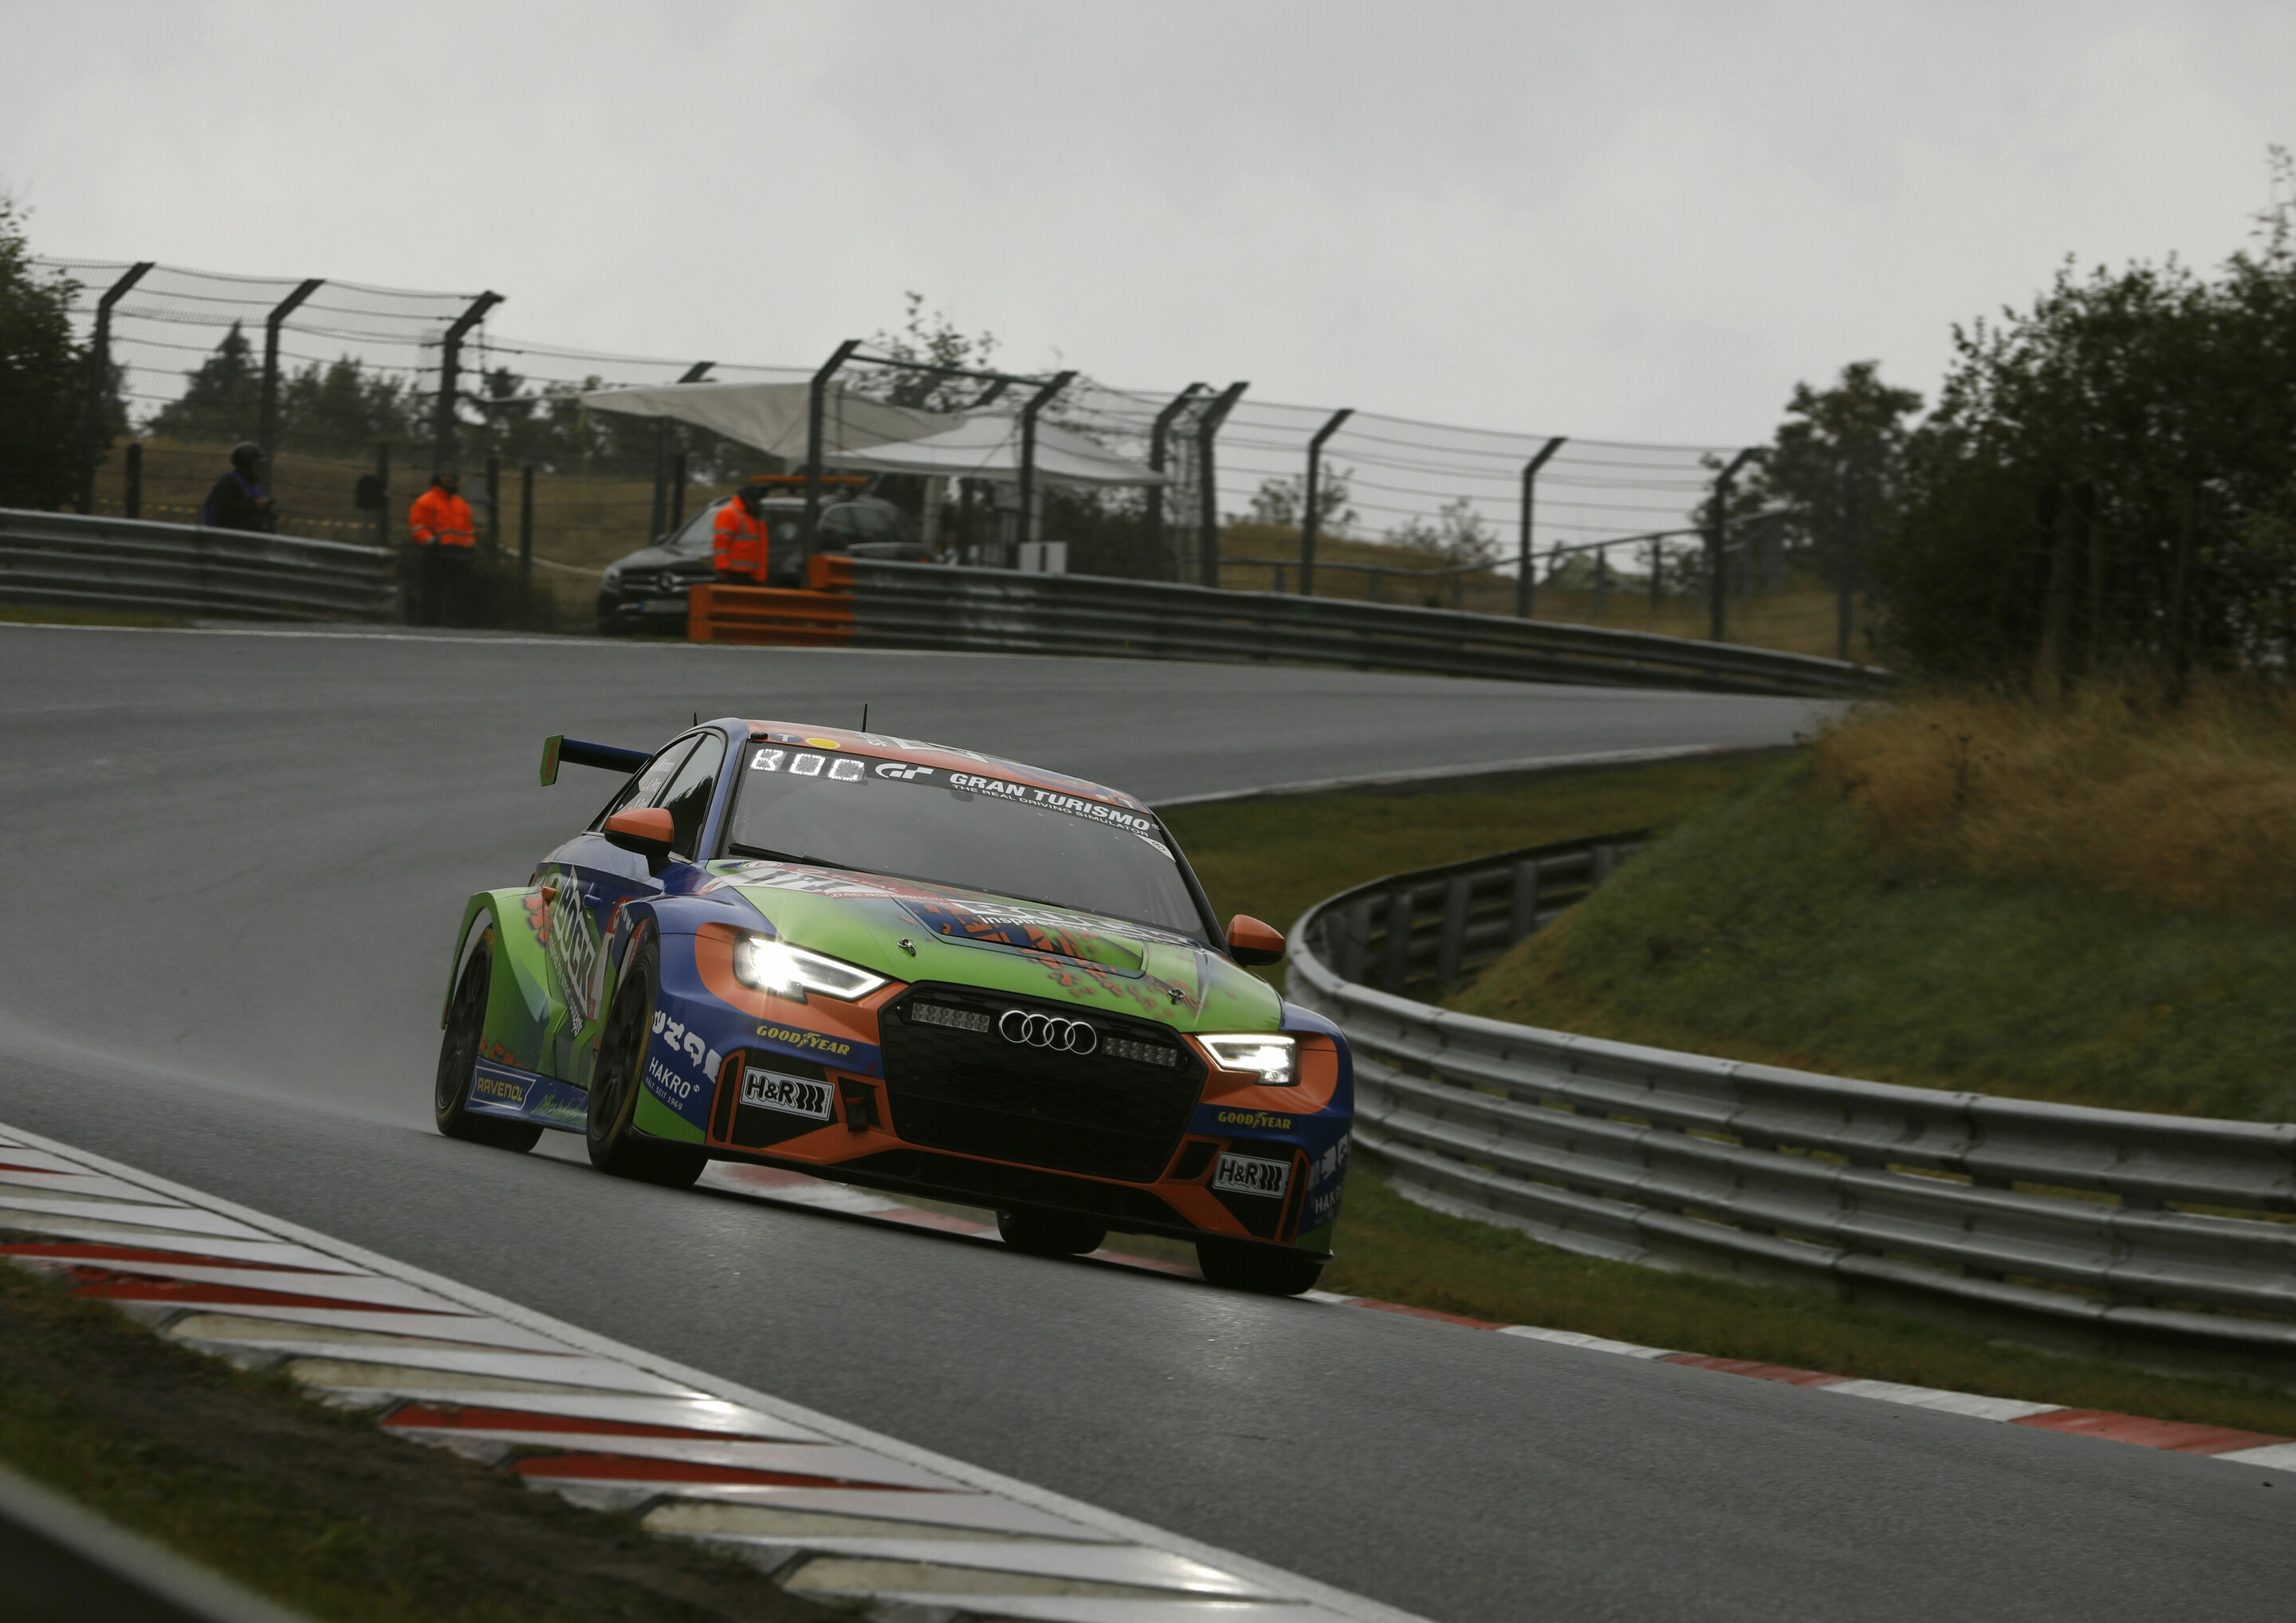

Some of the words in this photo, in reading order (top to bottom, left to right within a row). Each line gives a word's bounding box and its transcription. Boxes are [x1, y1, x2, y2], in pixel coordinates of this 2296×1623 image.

[875, 763, 934, 780] GT
[949, 773, 1025, 796] GRAN
[1034, 789, 1150, 831] TURISMO
[952, 784, 979, 793] THE
[982, 789, 1020, 802] REAL
[1020, 797, 1072, 814] DRIVING
[1076, 811, 1149, 837] SIMULATOR
[757, 1025, 851, 1056] GOODYEAR
[478, 1078, 525, 1102] RAVENOL
[649, 1056, 691, 1098] HAKRO
[747, 1074, 796, 1105] H&R
[655, 1087, 667, 1099] SEIT
[667, 1097, 683, 1110] 1969
[1218, 1111, 1292, 1130] GOODYEAR
[1218, 1158, 1261, 1186] H&R
